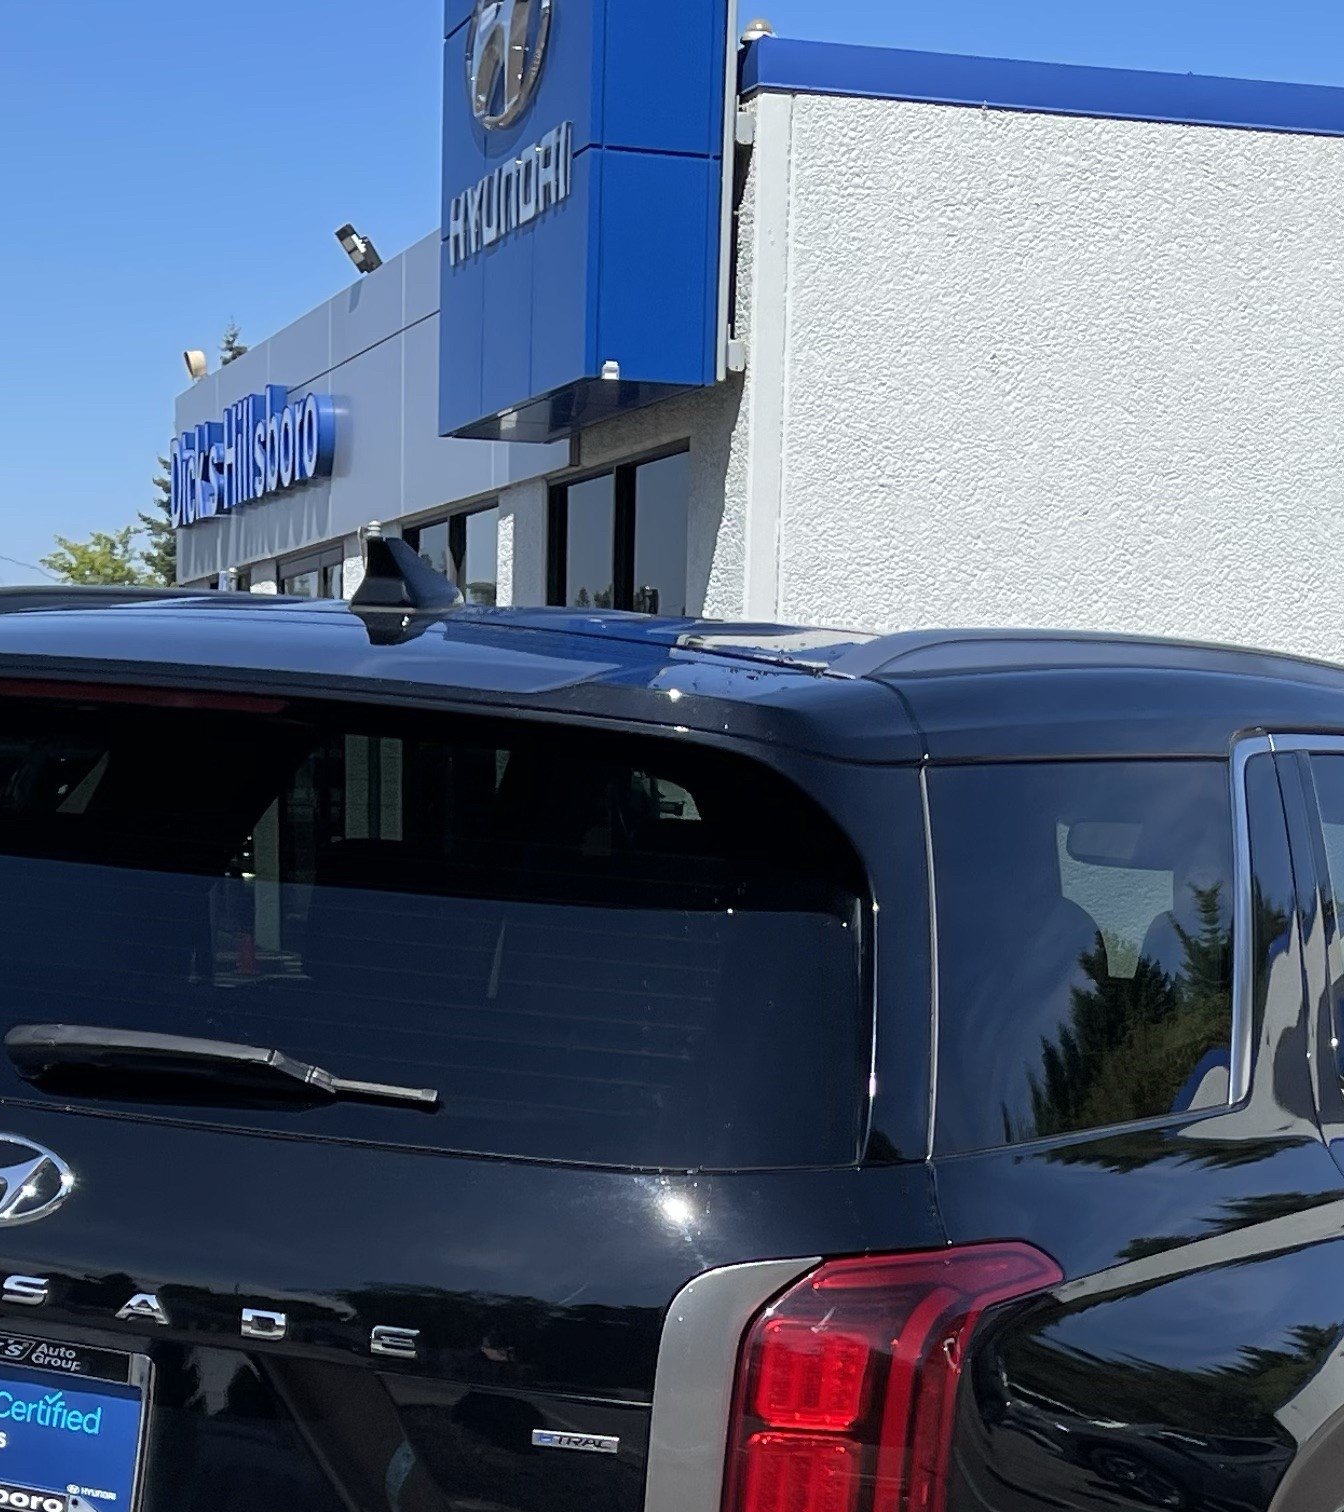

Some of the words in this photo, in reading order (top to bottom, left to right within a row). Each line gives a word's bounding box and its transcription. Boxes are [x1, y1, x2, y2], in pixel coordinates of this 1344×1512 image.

[449, 120, 573, 267] HYUNDAI
[223, 384, 324, 508] Hillsboro
[31, 1352, 82, 1372] Group
[36, 1343, 77, 1359] Auto
